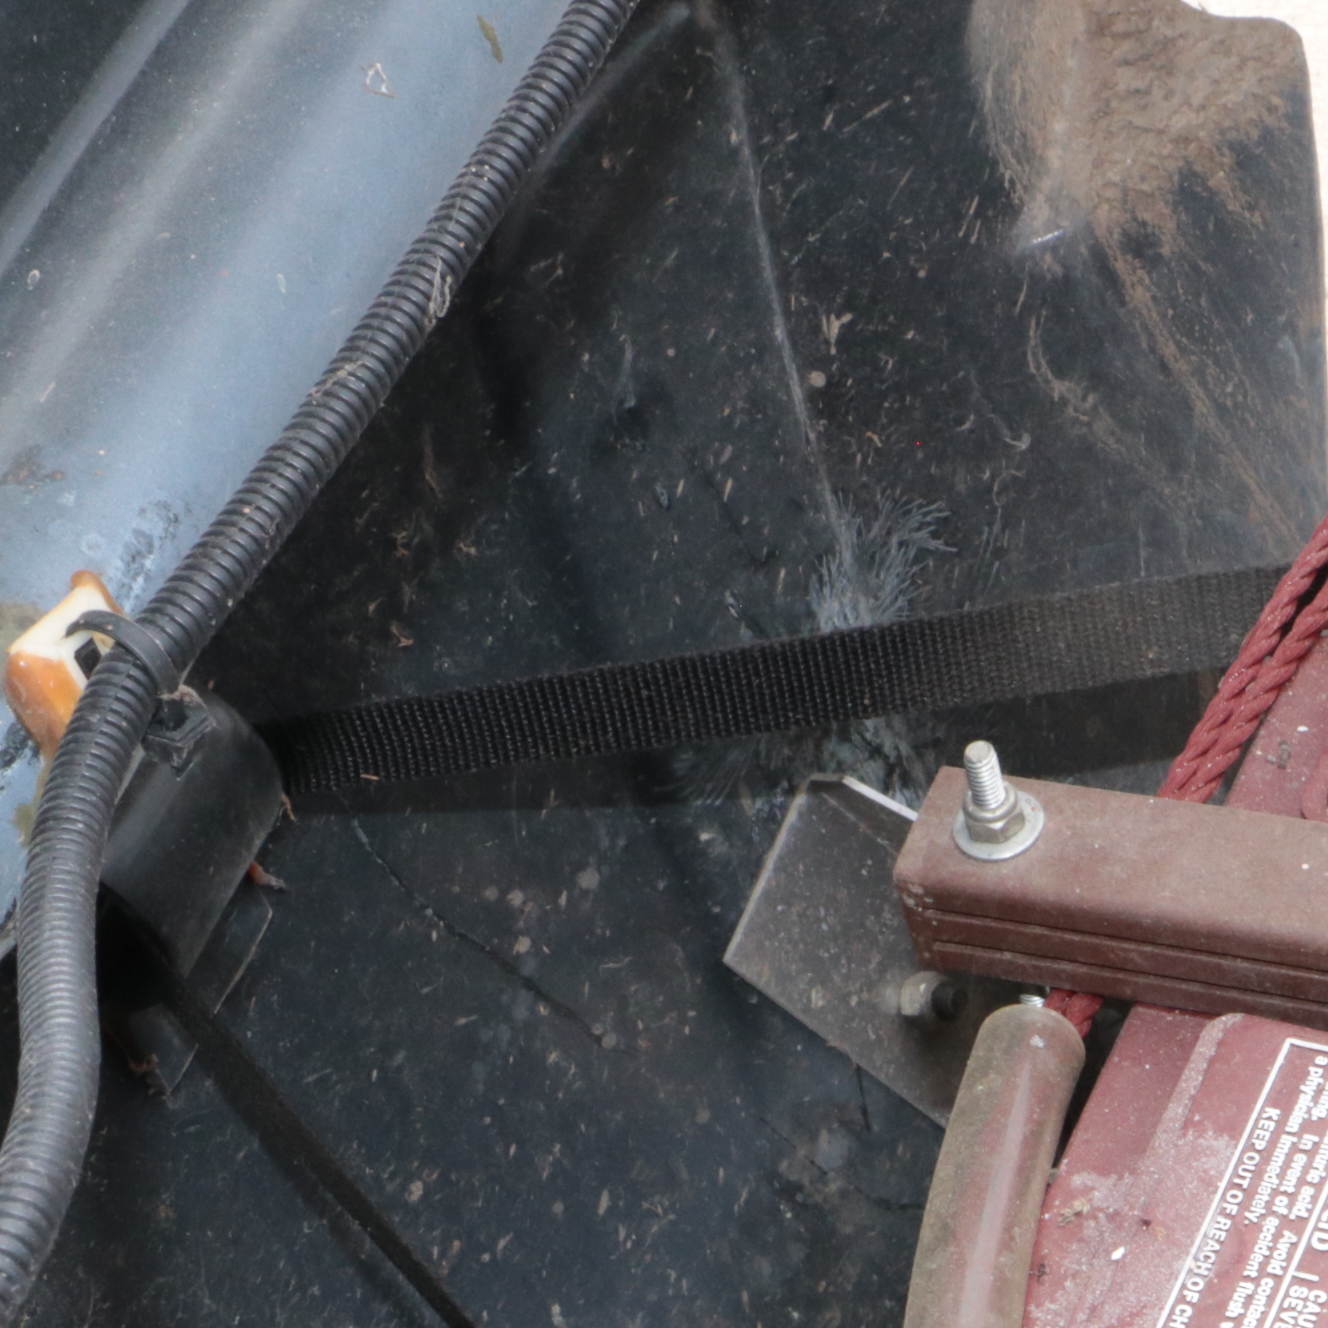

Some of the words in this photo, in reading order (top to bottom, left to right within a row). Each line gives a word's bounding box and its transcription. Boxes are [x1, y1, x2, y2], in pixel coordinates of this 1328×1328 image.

[1314, 1055, 1328, 1065] a
[1285, 1066, 1324, 1133] physician
[1251, 1107, 1281, 1150] KEEP
[1298, 1134, 1320, 1150] In
[1233, 1152, 1260, 1189] OUT
[1244, 1134, 1298, 1224] immediately.
[1279, 1153, 1307, 1193] event
[1221, 1190, 1243, 1215] OF
[1272, 1195, 1289, 1215] of
[1289, 1185, 1315, 1220] acid.
[1192, 1215, 1231, 1276] REACH
[1243, 1216, 1280, 1278] accident
[1266, 1230, 1298, 1275] Avoid
[1183, 1276, 1204, 1303] OF
[1225, 1281, 1255, 1318] flush
